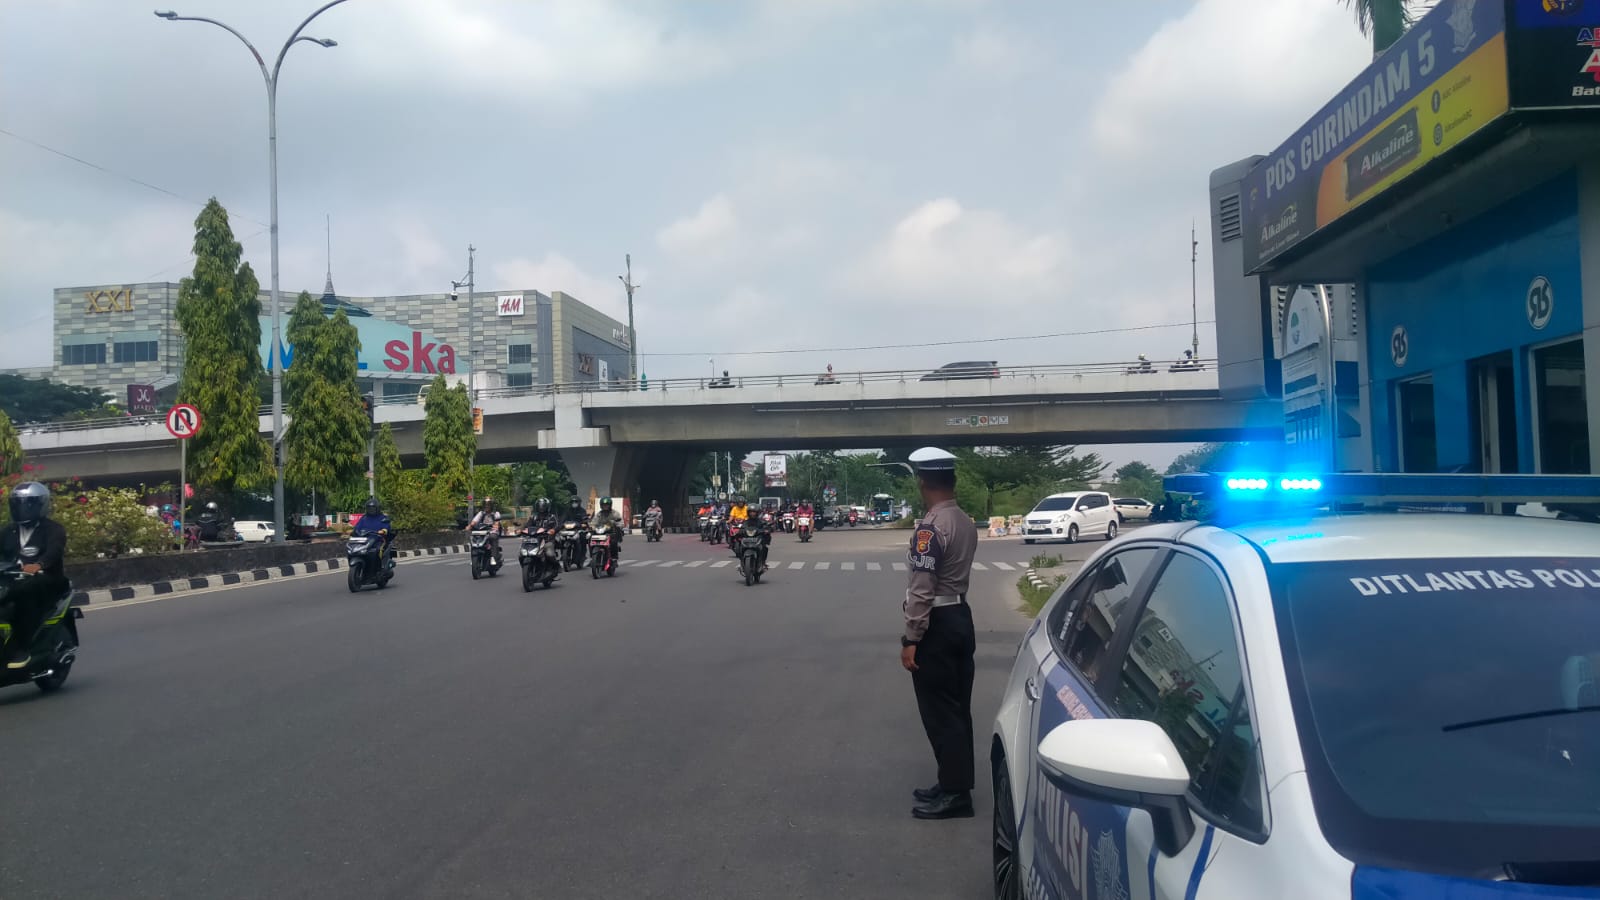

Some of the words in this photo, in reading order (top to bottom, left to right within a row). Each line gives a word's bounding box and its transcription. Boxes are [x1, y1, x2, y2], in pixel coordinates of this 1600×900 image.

[1265, 150, 1296, 199] POS
[1301, 51, 1411, 171] GURINDAM
[1418, 30, 1435, 76] 5
[1361, 129, 1414, 177] Alkaline
[1261, 211, 1298, 244] Alkaline
[85, 288, 133, 313] XXI
[501, 298, 521, 313] H&M
[383, 331, 456, 375] ska
[1350, 568, 1535, 597] DITLANTAS
